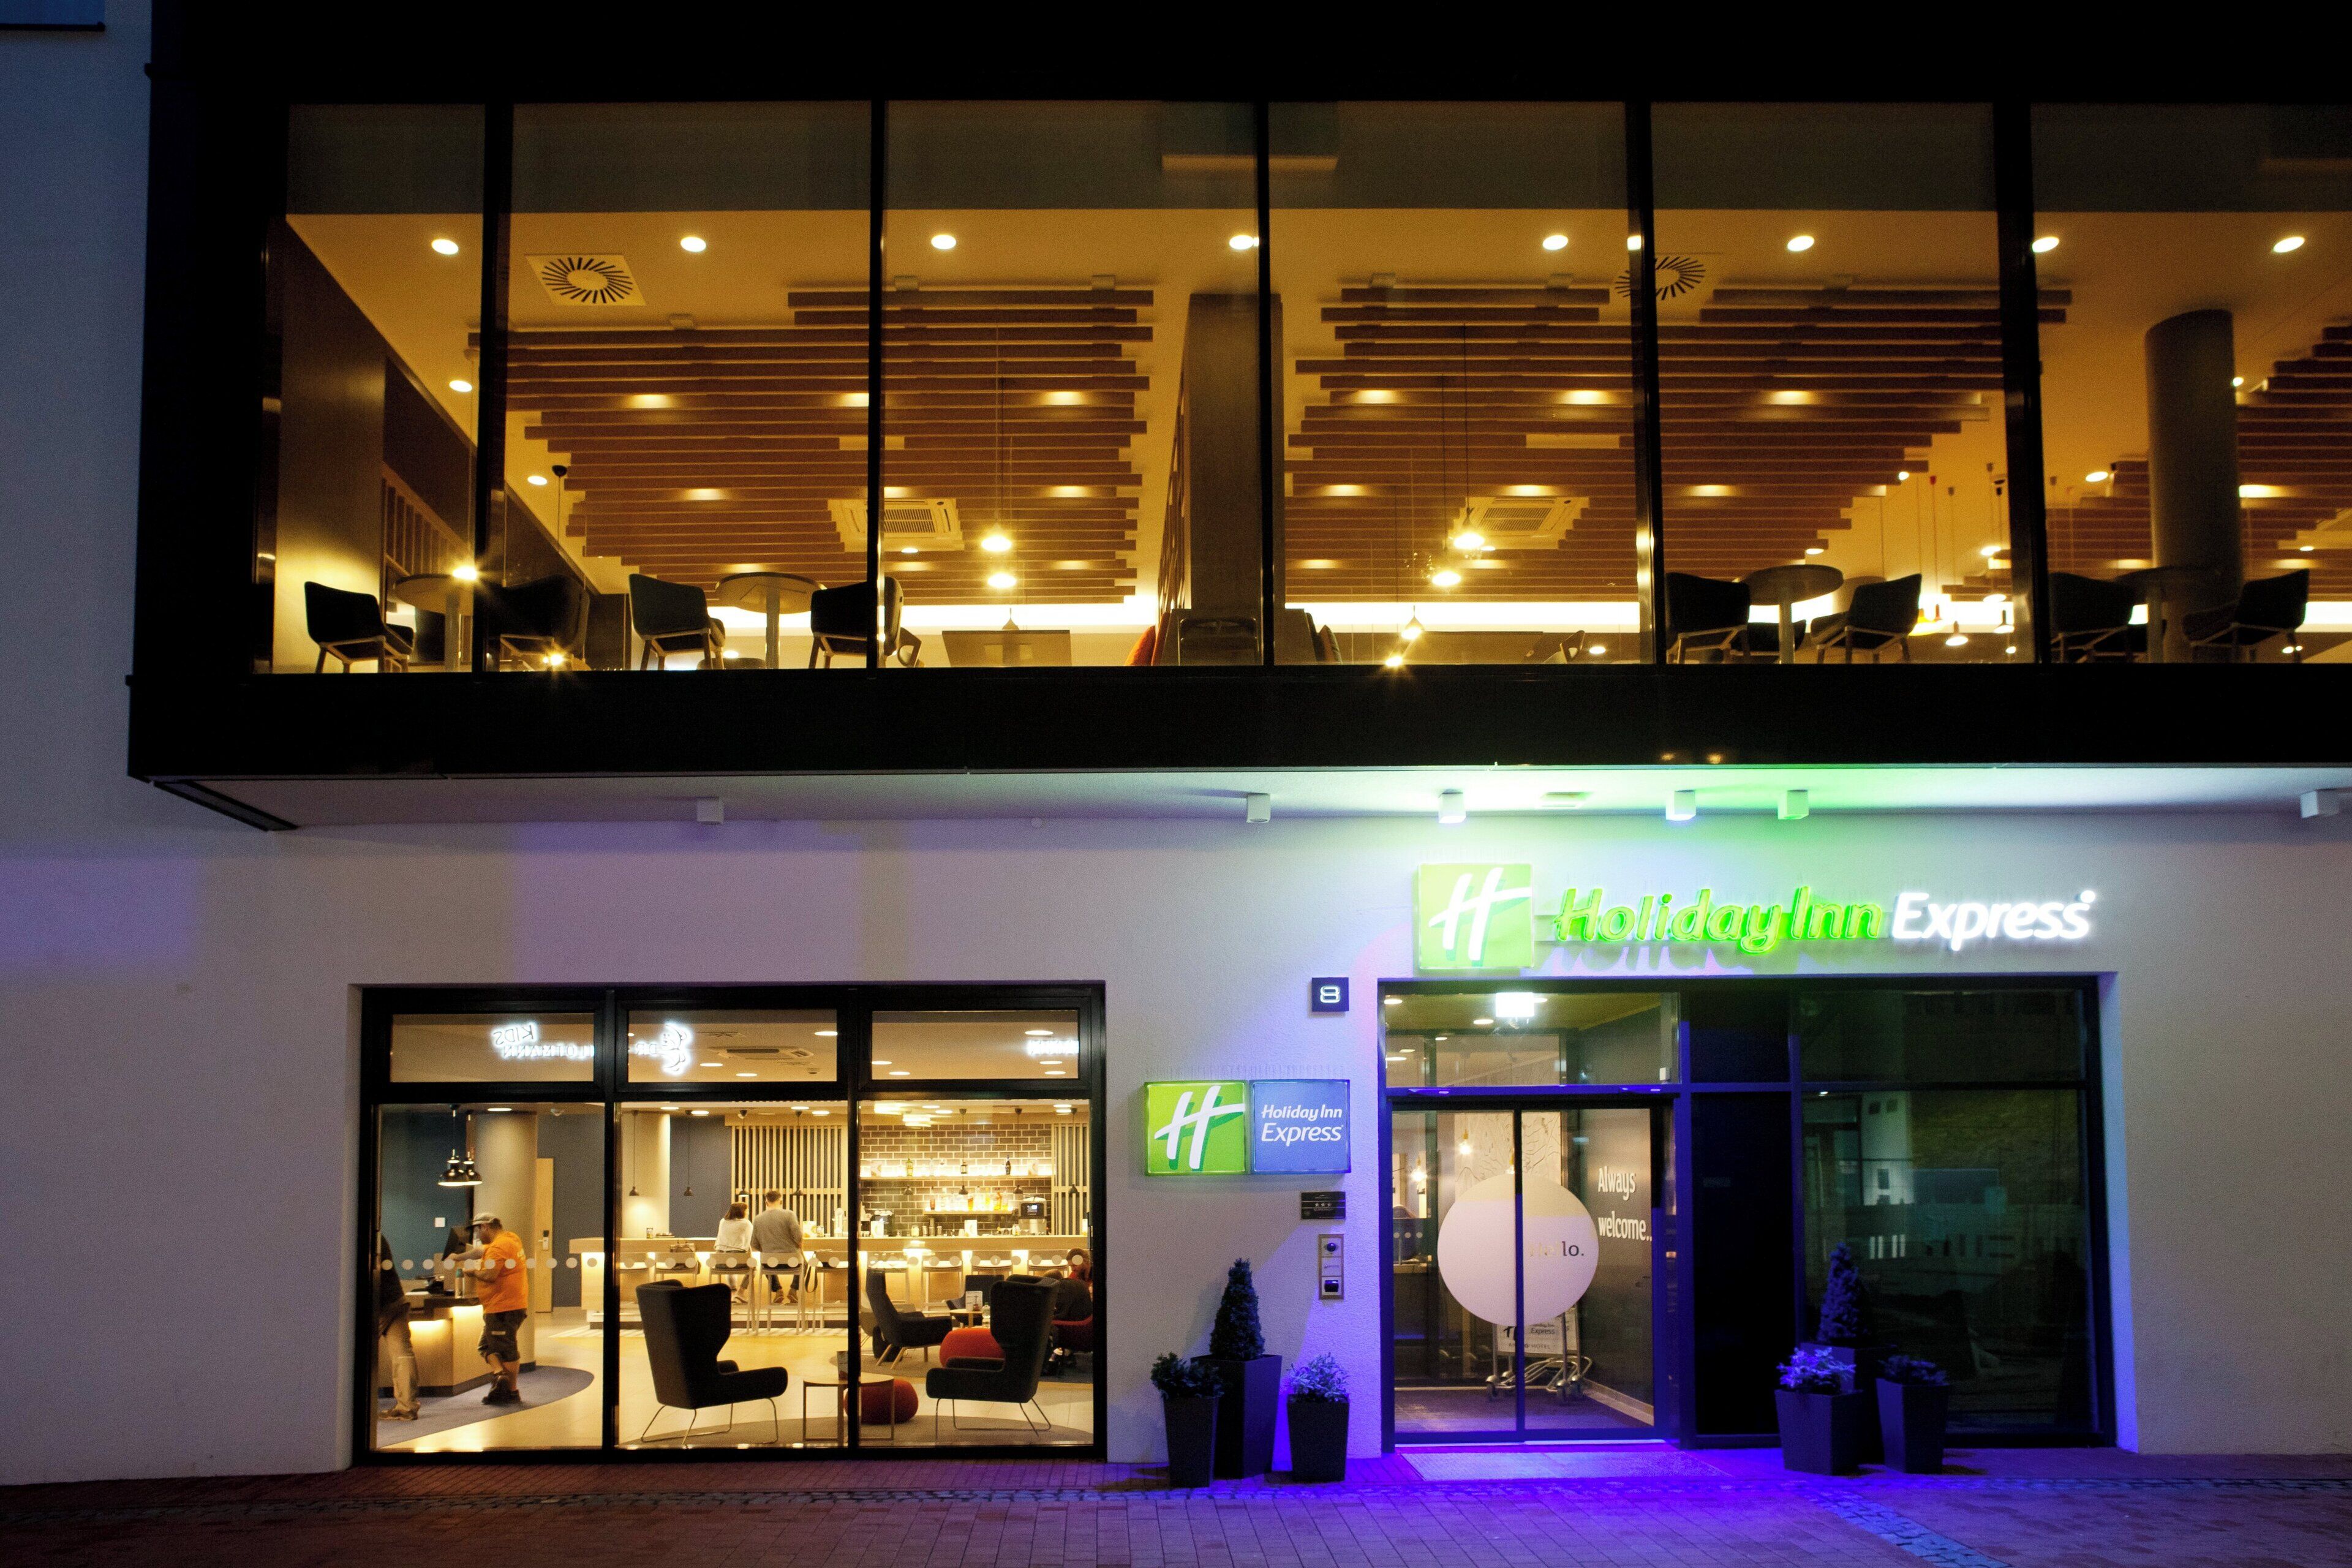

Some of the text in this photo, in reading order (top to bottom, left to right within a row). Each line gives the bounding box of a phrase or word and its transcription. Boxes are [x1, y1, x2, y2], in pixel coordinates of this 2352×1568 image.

[1555, 886, 2095, 953] Holiday Inn Express
[1320, 985, 1340, 1003] 8
[1261, 1104, 1343, 1121] Holiday Inn
[1261, 1122, 1344, 1147] Express
[1597, 1166, 1637, 1201] Always
